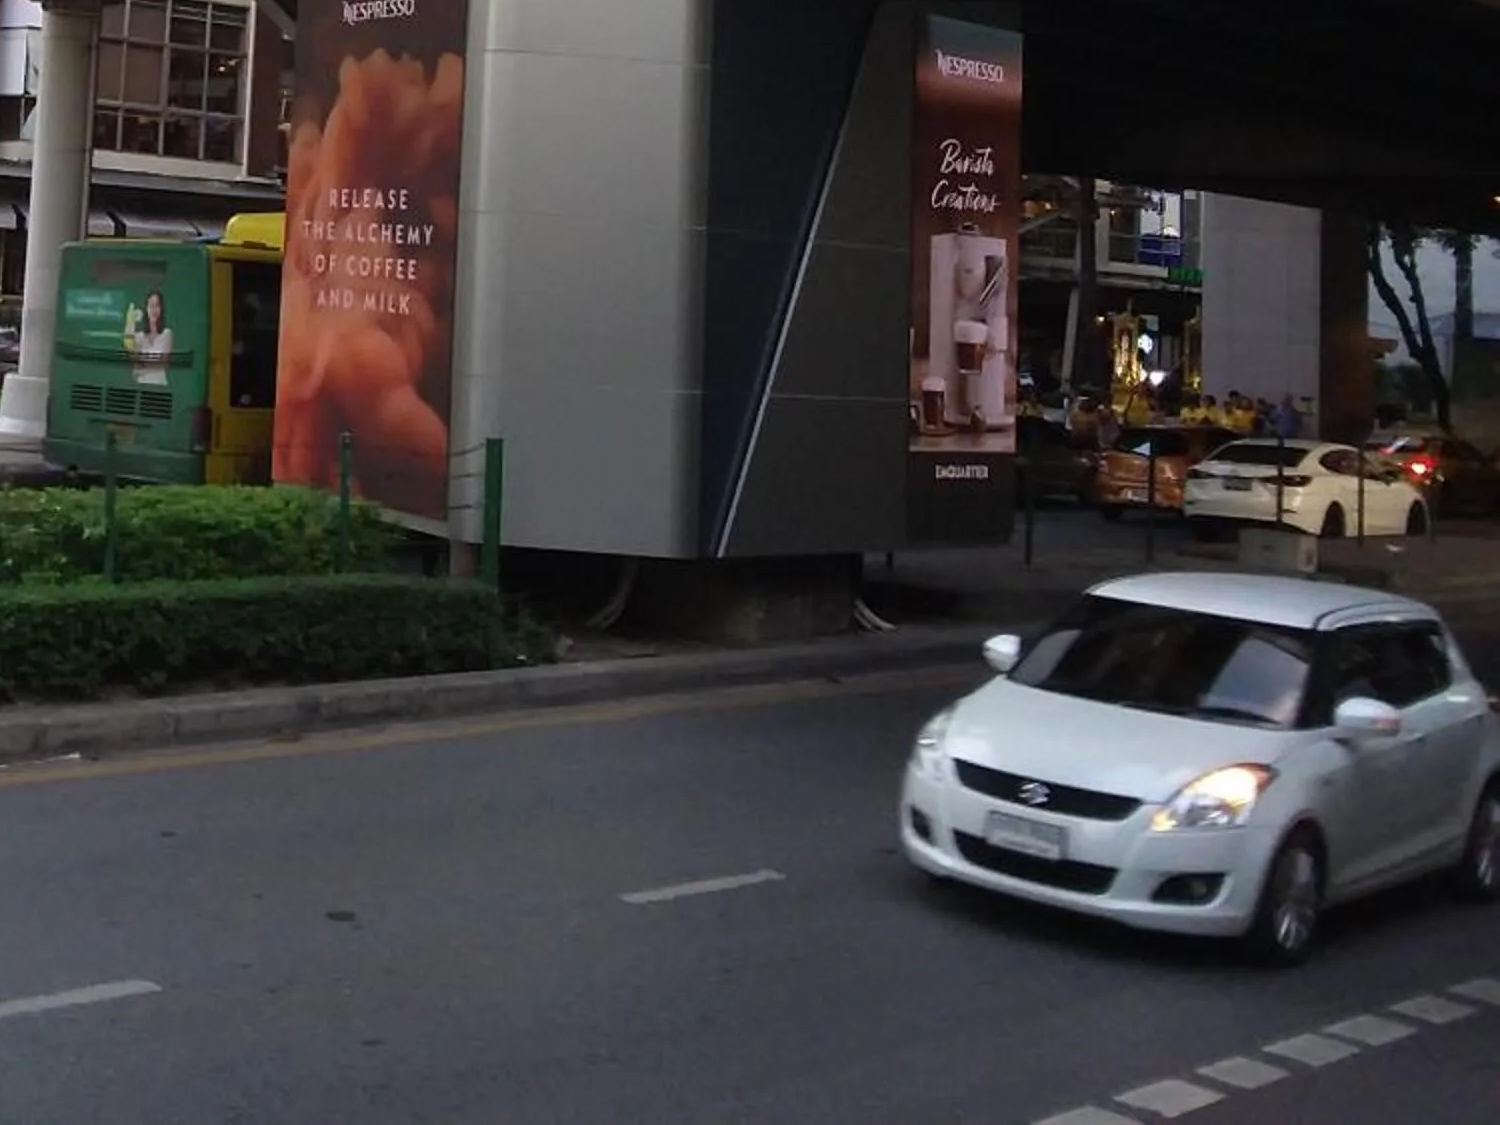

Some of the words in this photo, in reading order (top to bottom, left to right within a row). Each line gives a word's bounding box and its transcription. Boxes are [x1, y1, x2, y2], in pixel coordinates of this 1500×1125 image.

[934, 48, 1004, 83] NESPRESSO
[940, 138, 994, 176] Barista
[329, 187, 409, 210] RELEASE
[931, 179, 1000, 213] Creations
[302, 220, 336, 241] THE
[344, 222, 434, 246] ALCHEMY
[315, 254, 337, 273] OF
[346, 256, 417, 280] COFFEE
[317, 288, 353, 309] AND
[363, 292, 410, 315] MILK
